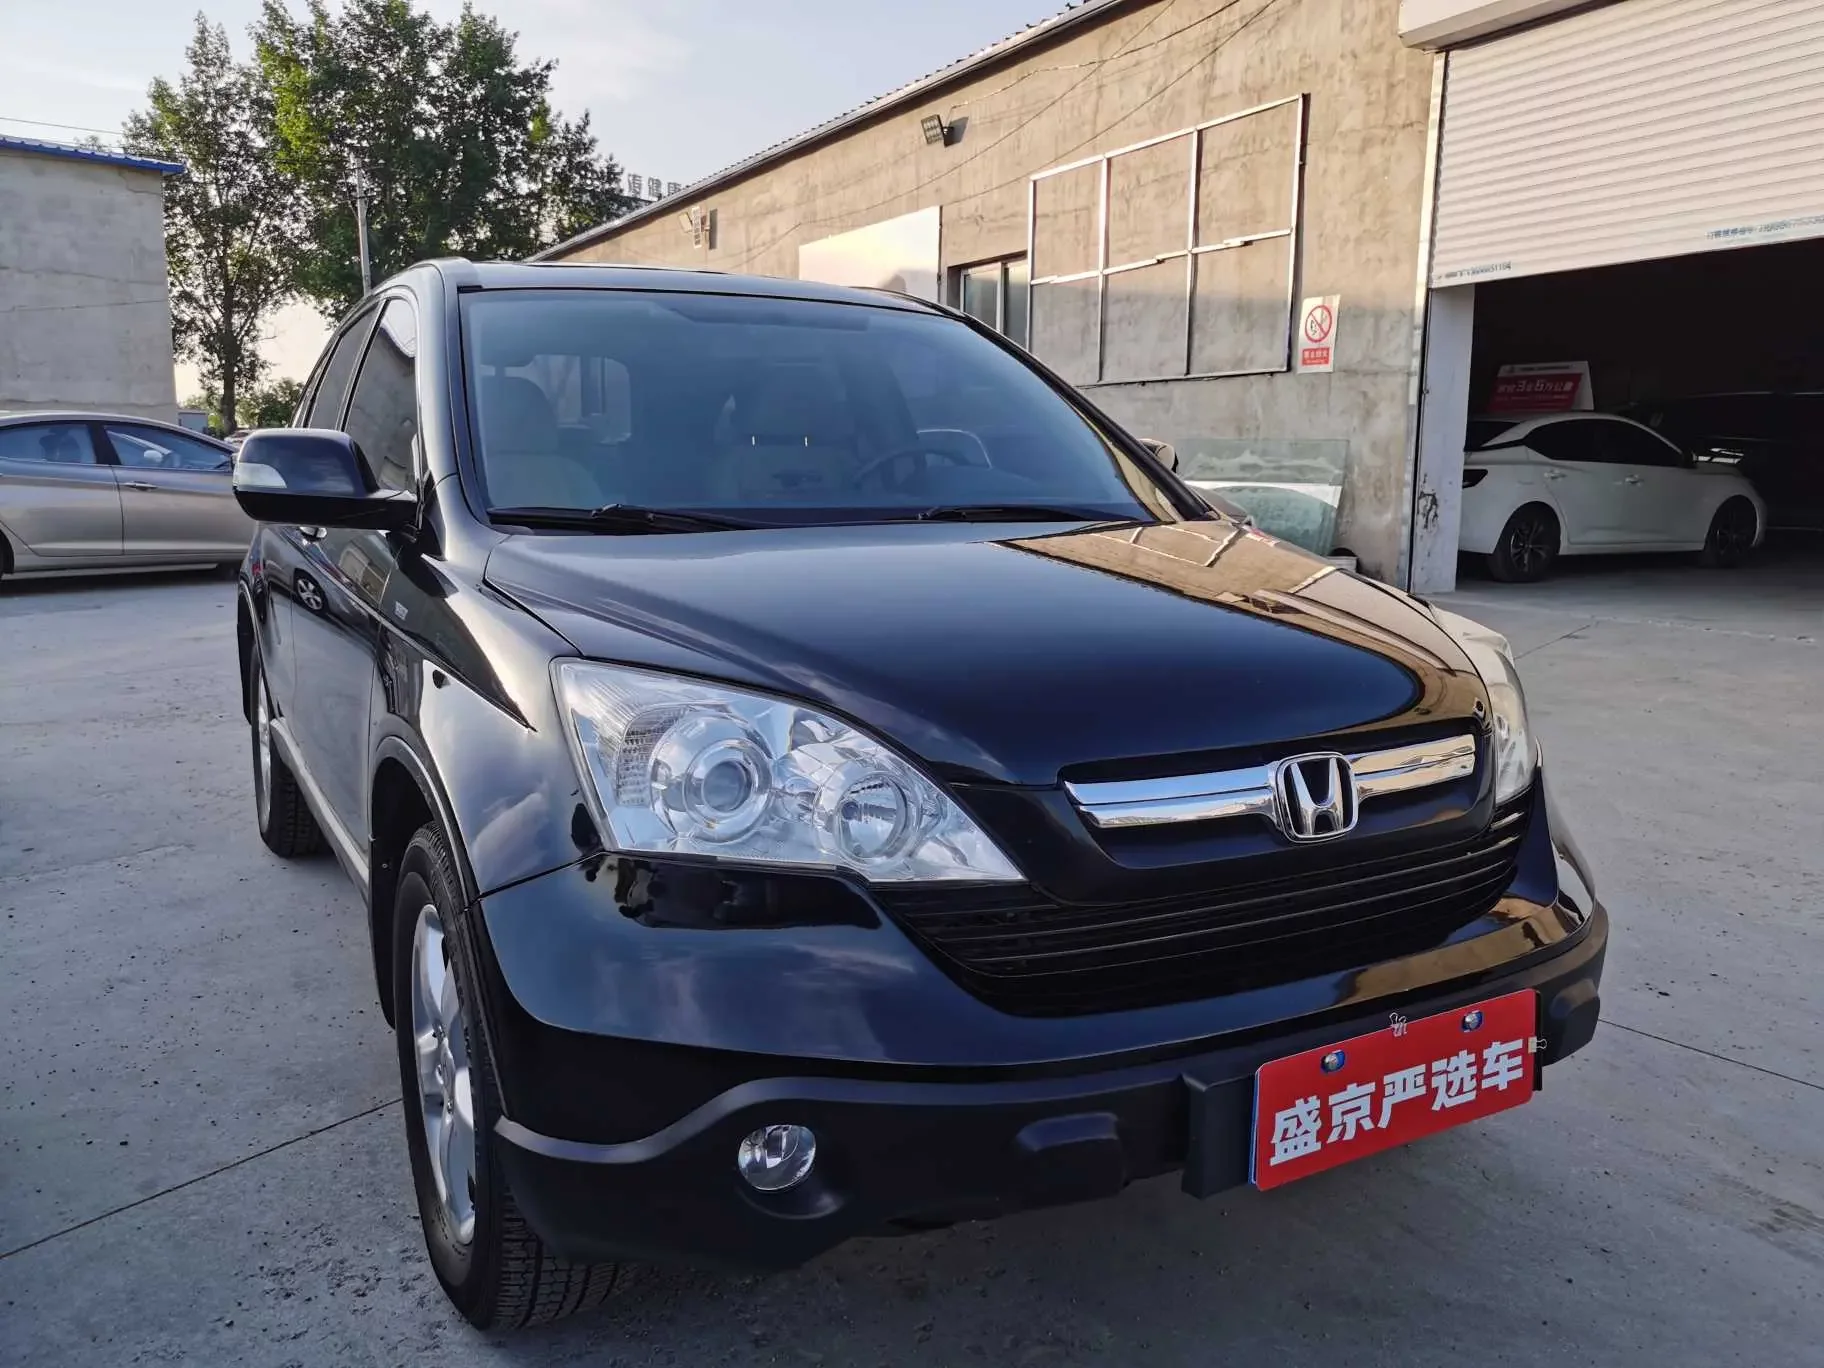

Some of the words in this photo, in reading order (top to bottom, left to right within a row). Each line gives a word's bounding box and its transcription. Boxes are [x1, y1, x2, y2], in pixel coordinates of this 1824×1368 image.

[1269, 1038, 1524, 1167] 盛京严选车
